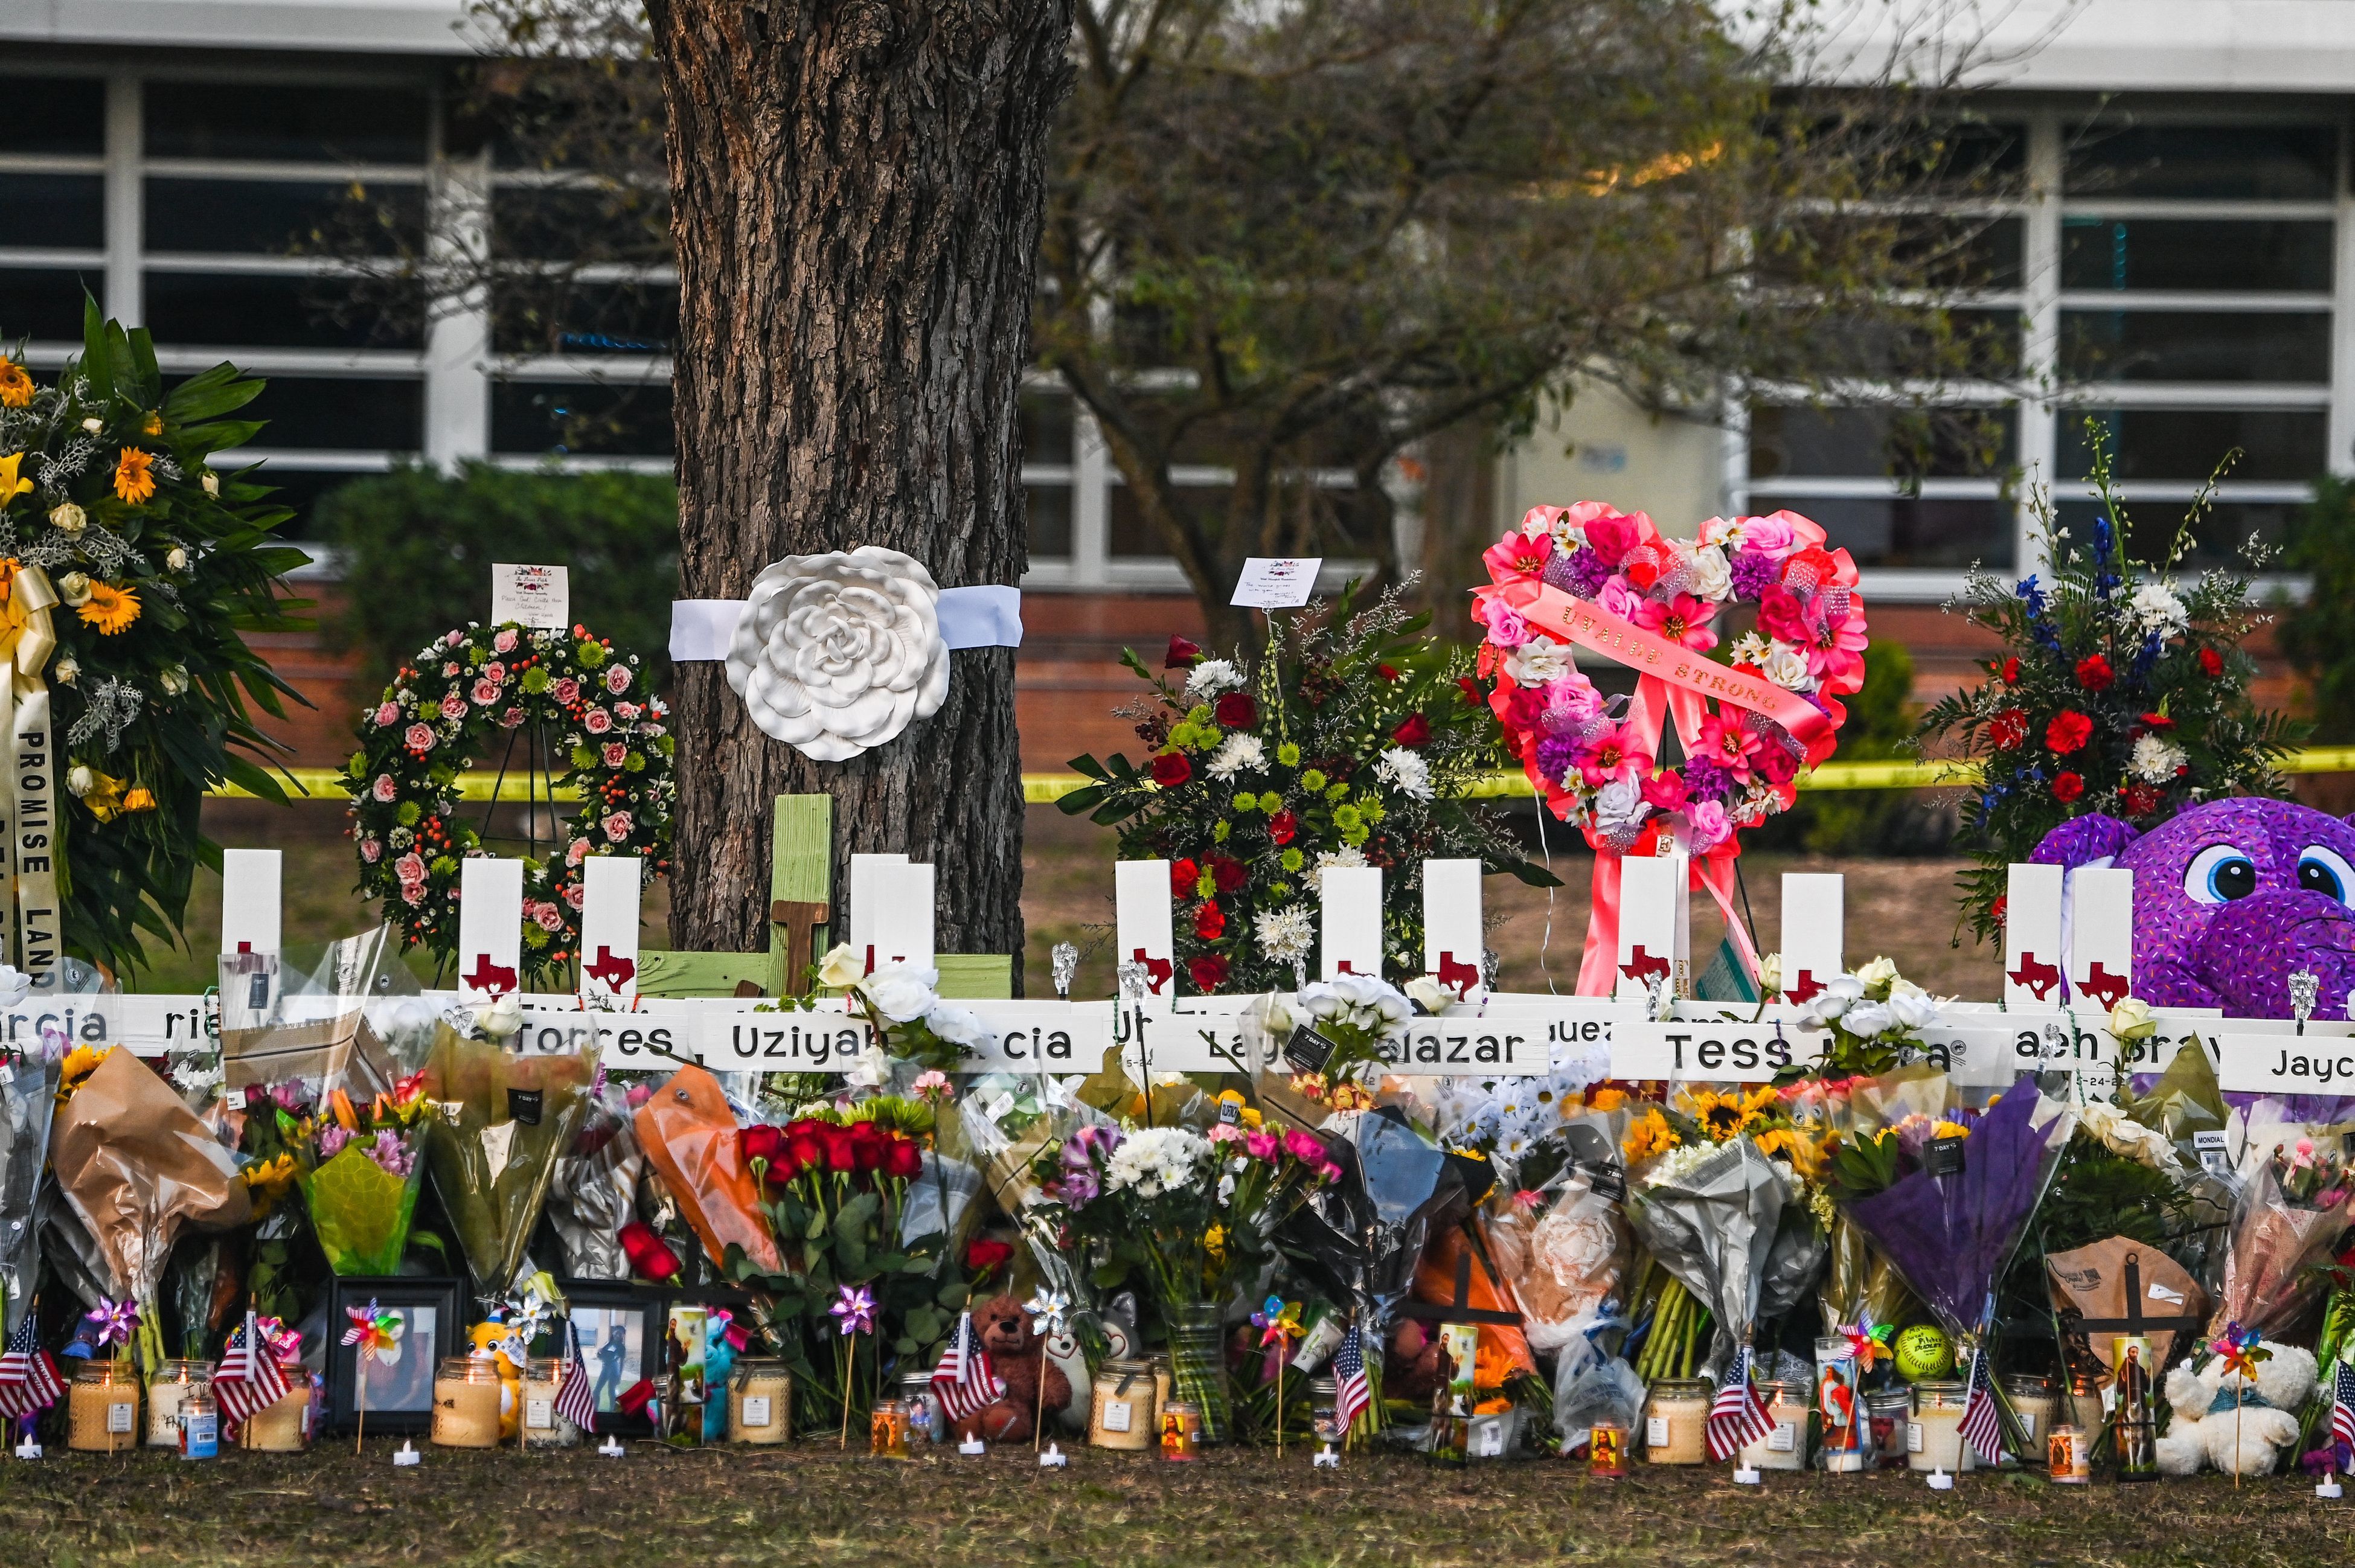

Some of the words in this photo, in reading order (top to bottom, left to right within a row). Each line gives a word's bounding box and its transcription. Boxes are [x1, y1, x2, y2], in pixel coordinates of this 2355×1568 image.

[1562, 606, 1663, 665] UVALDE
[1674, 664, 1779, 711] STRONG
[18, 732, 50, 874] PROMISE
[732, 1024, 889, 1065] Uziyah
[1309, 1037, 1321, 1046] DAY
[1665, 1034, 1792, 1070] Tess
[278, 1332, 299, 1349] Barbie
